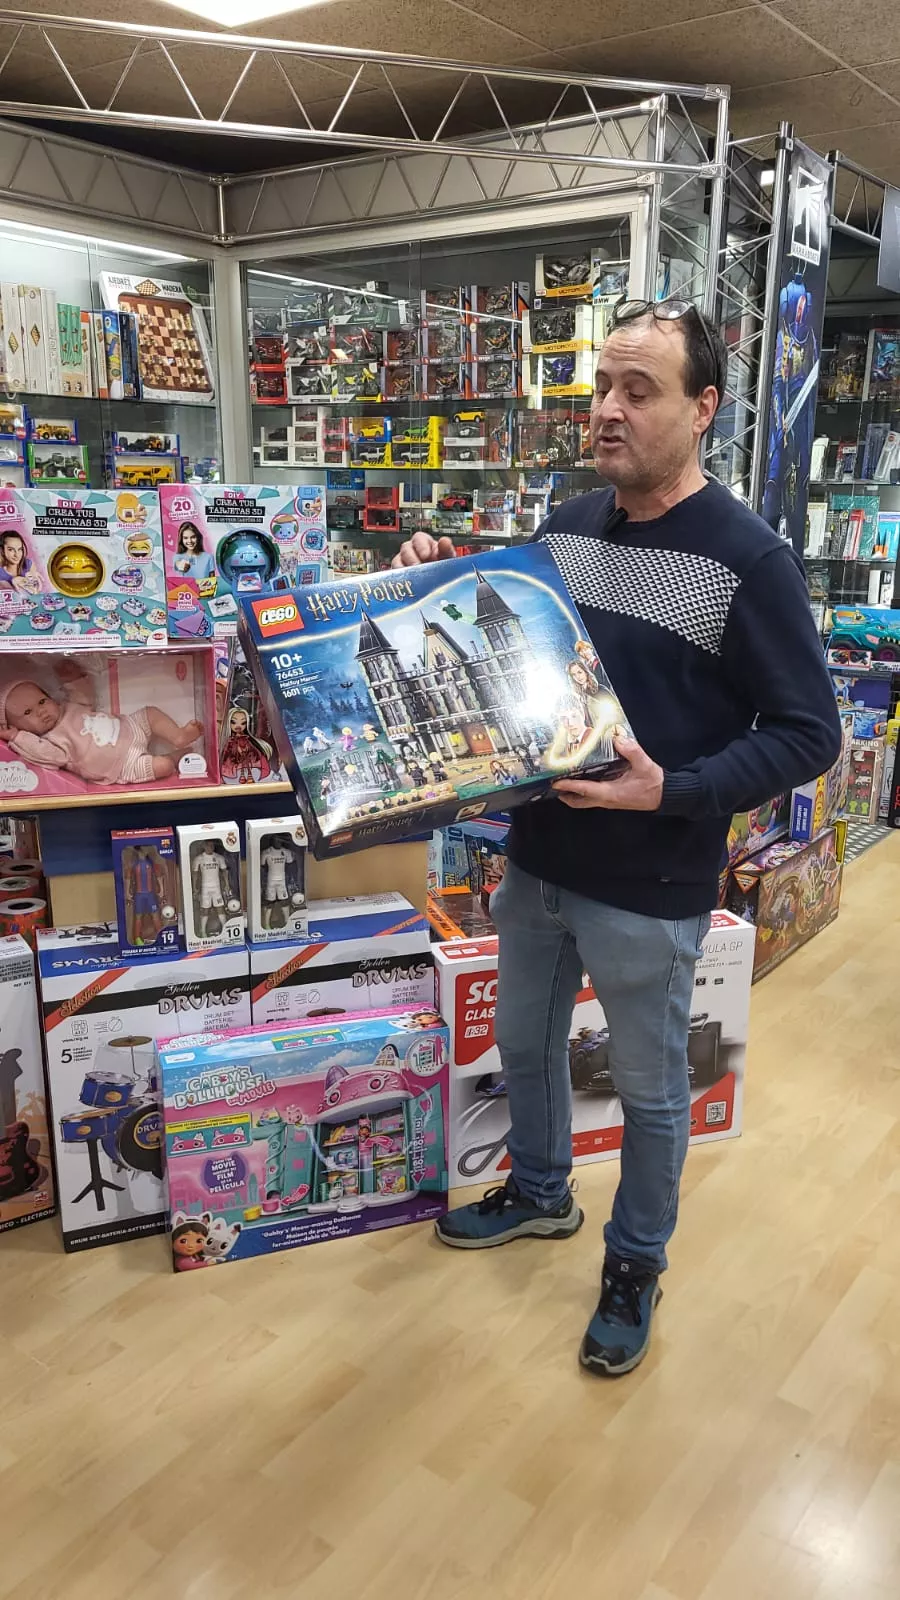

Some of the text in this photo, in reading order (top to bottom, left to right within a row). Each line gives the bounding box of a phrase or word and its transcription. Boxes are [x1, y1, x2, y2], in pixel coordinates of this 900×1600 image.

[174, 501, 191, 511] 20
[216, 499, 238, 507] CREA
[48, 508, 95, 518] CREA TUS
[208, 507, 263, 516] TARJETAS 3D
[37, 517, 92, 527] PEGATINAS
[93, 519, 107, 528] 3D
[179, 592, 192, 600] 20
[306, 579, 415, 621] Harry Potter
[261, 606, 295, 624] LEGO
[270, 653, 302, 670] 10+
[276, 669, 304, 681] 76453
[280, 674, 318, 689] Malfoy Manor
[282, 686, 314, 698] 1601 pcs
[851, 740, 879, 748] ARKING
[295, 921, 301, 930] 6
[161, 933, 174, 944] 19
[227, 928, 240, 939] 10
[268, 930, 287, 938] Madrid
[202, 938, 222, 946] Madrid
[729, 941, 743, 952] GP
[358, 958, 391, 970] Golden
[352, 963, 427, 987] DRUMS
[164, 982, 200, 995] Golden
[465, 979, 498, 1005] SC
[61, 984, 101, 1017] Selection
[158, 988, 242, 1015] DRUMS
[465, 1007, 496, 1021] CLAS
[61, 1048, 72, 1064] 5
[189, 1069, 249, 1092] GABBY'S
[175, 1075, 264, 1109] DOLLHOUSE
[239, 1082, 273, 1103] MOVIE
[137, 1123, 158, 1134] DRU
[211, 1160, 237, 1171] MOVIE
[216, 1171, 234, 1181] FILM
[210, 1180, 245, 1194] PELÍCULA
